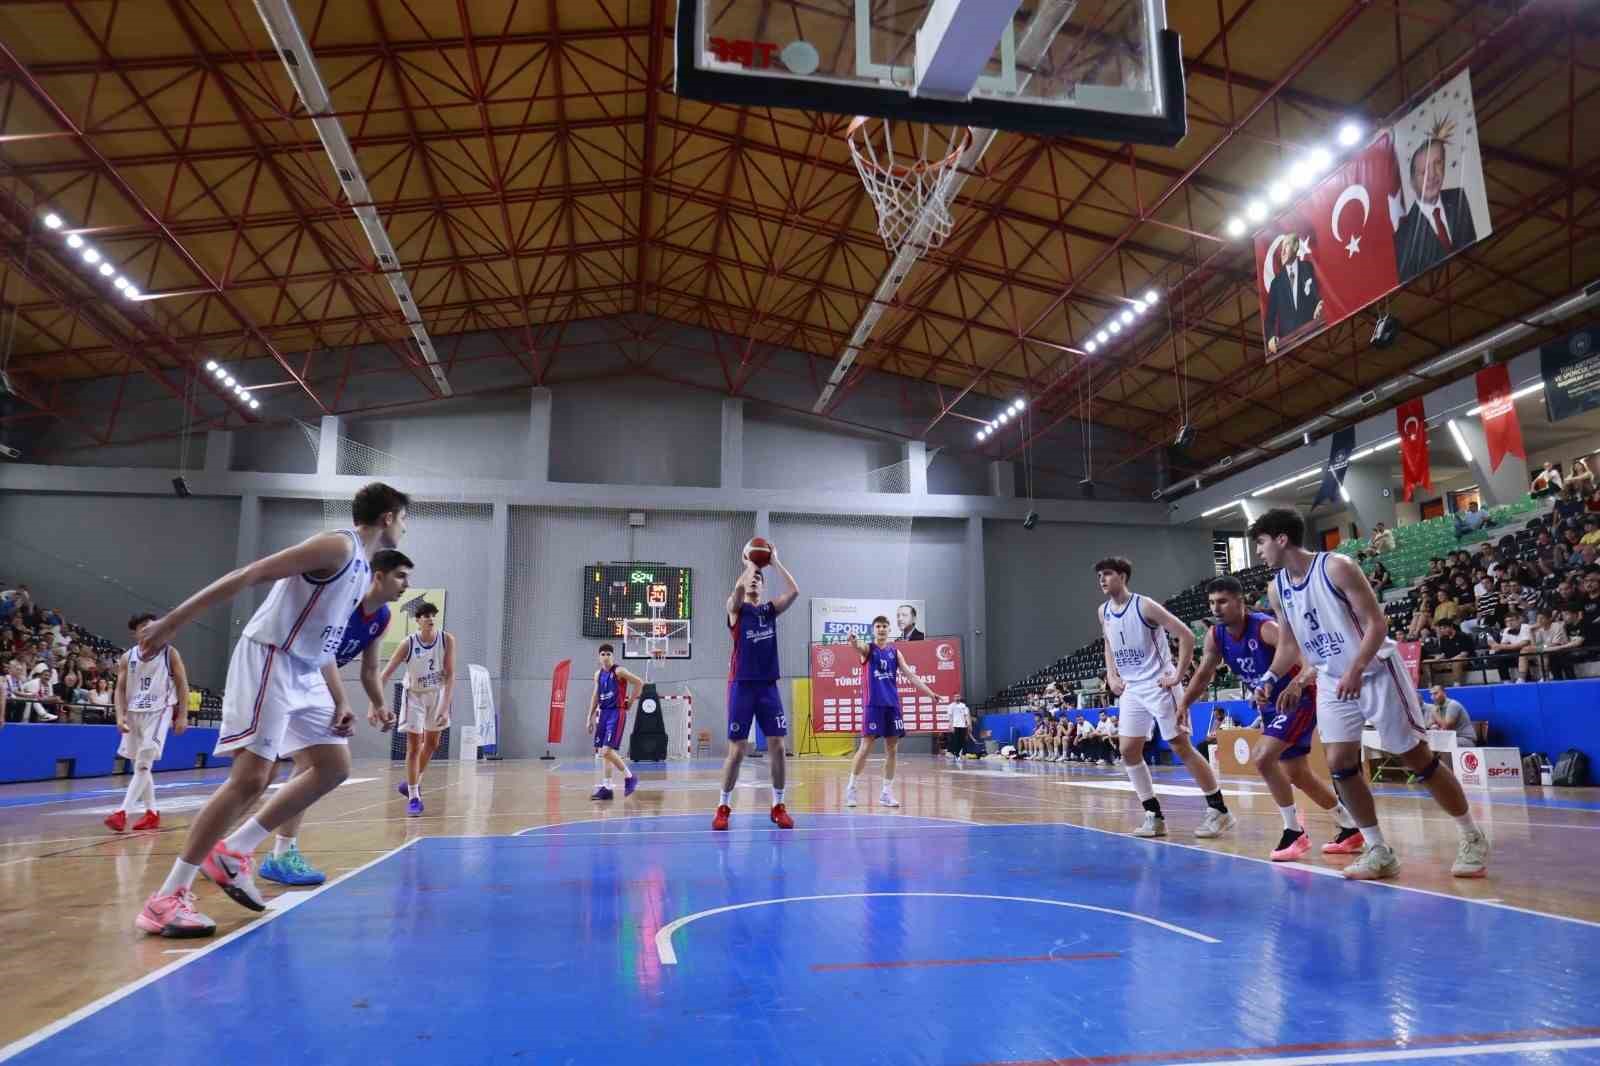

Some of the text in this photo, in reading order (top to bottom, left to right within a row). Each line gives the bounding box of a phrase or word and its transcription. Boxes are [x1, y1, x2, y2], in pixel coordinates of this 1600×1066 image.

[829, 623, 868, 634] SPORU
[1120, 631, 1126, 646] 1
[428, 658, 435, 671] 2
[1236, 657, 1256, 673] 22
[894, 719, 904, 730] 10
